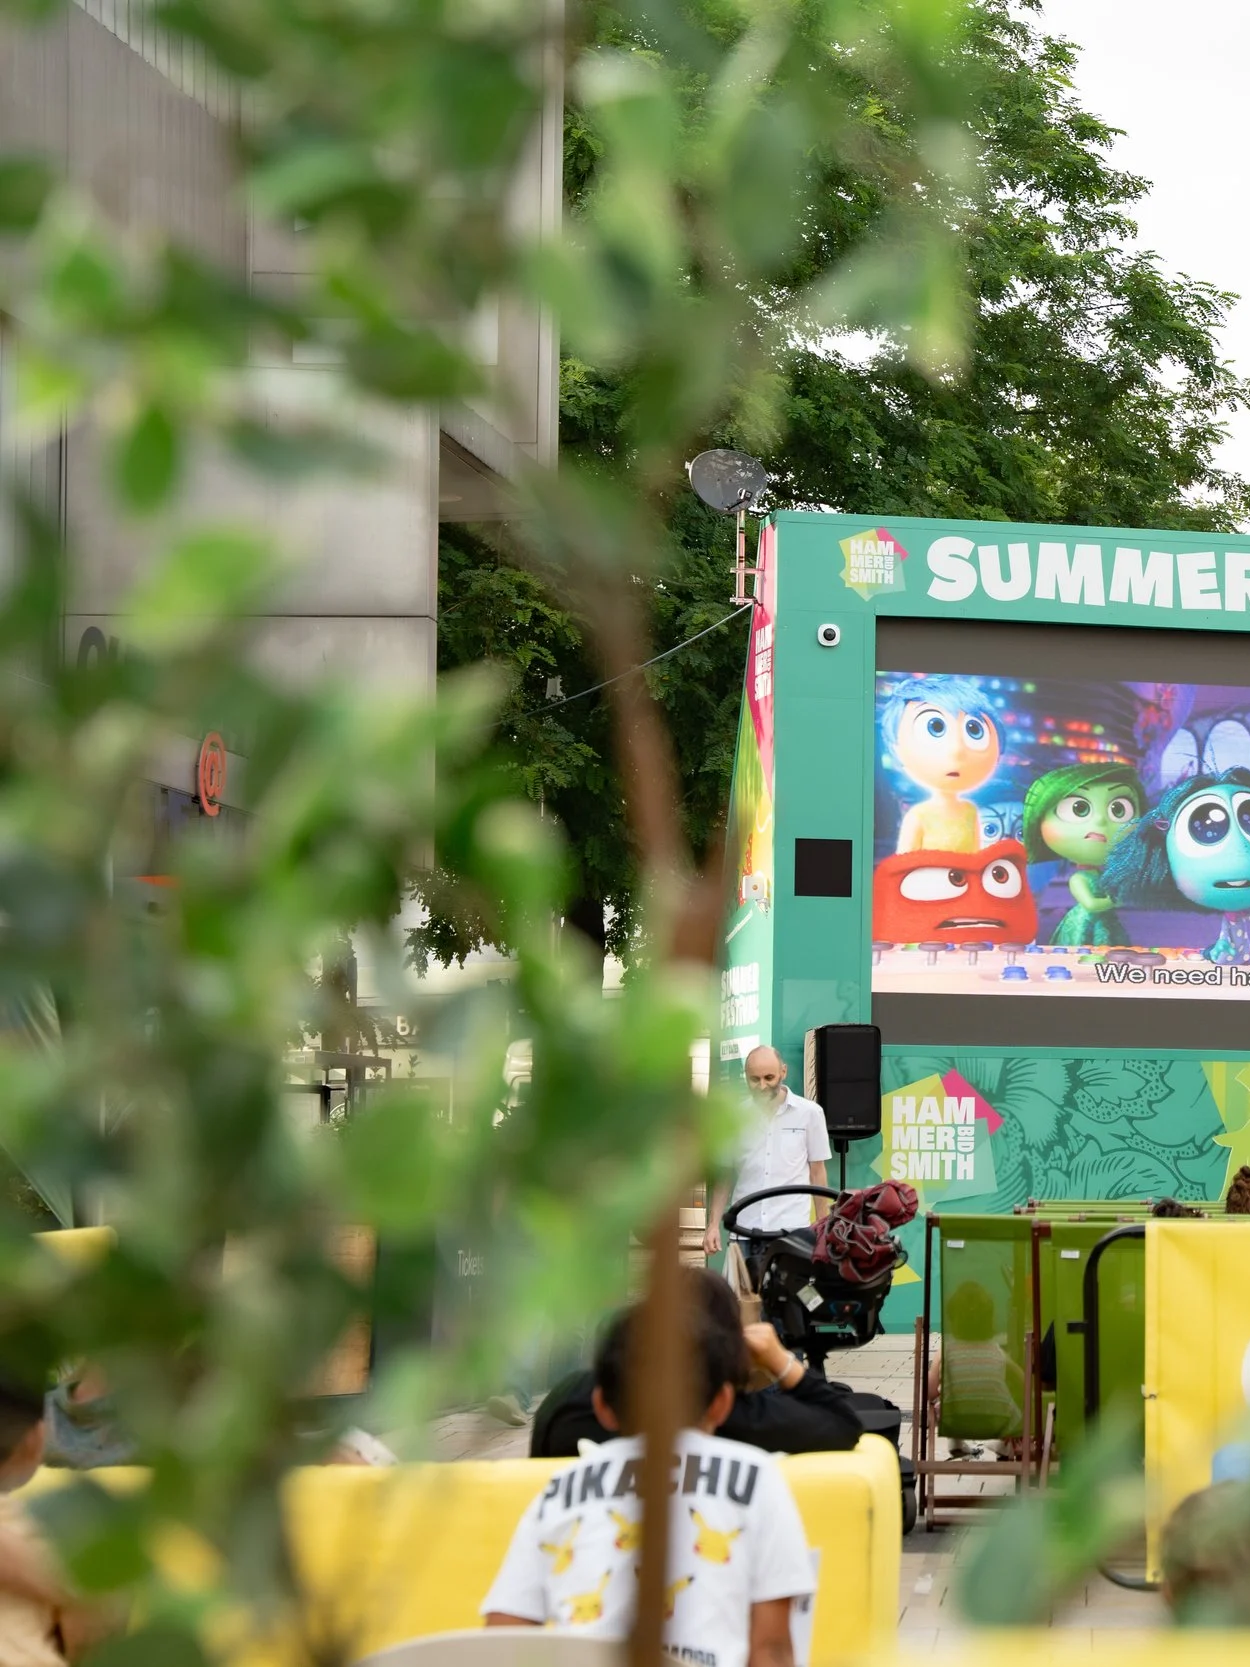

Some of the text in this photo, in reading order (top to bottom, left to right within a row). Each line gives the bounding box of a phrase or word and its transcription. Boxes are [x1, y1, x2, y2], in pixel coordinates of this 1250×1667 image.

[850, 540, 894, 555] HAM
[850, 554, 884, 568] MER
[850, 567, 894, 584] SMITH
[1095, 963, 1146, 984] We
[1152, 966, 1221, 985] need
[892, 1096, 975, 1125] HAM
[892, 1125, 956, 1150] MER
[957, 1126, 975, 1153] BID
[890, 1151, 975, 1180] SMITH
